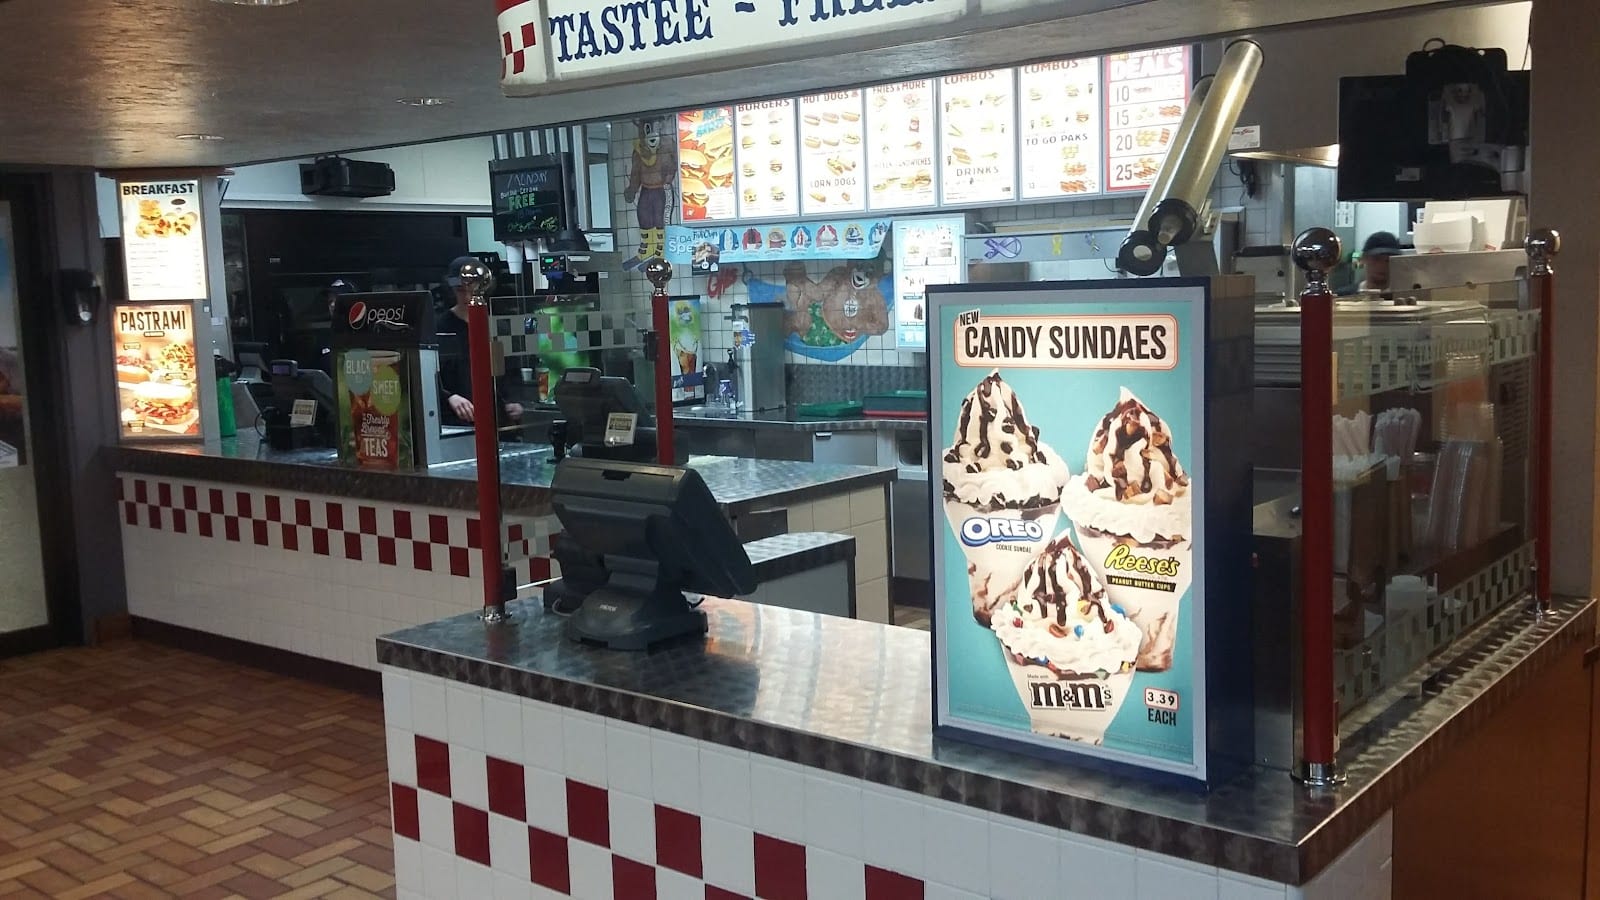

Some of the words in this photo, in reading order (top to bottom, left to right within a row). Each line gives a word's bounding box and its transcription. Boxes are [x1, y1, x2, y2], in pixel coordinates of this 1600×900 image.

[549, 0, 714, 62] TASTEE
[1024, 60, 1078, 74] COMBOS
[944, 70, 995, 85] COMBOS
[873, 84, 895, 94] FRIES
[902, 80, 926, 91] MORE
[1115, 86, 1130, 102] 10
[803, 94, 821, 104] HOT
[824, 91, 849, 102] DOGS
[738, 100, 790, 113] BURGERS
[1115, 108, 1130, 126] 15
[1026, 138, 1038, 146] TO
[1042, 136, 1057, 145] GO
[1061, 133, 1088, 143] PAKS
[1115, 134, 1133, 151] 20
[956, 166, 999, 177] DRINKS
[1115, 164, 1133, 181] 25
[123, 183, 195, 196] BREAKFAST
[834, 177, 857, 187] DOGS
[508, 192, 536, 211] FREE
[120, 311, 186, 331] PASTRAMI
[367, 304, 406, 325] pepsi
[959, 311, 980, 327] NEW
[964, 325, 1043, 358] CANDY
[1049, 325, 1167, 360] SUNDAES
[346, 360, 371, 375] BLACK
[372, 380, 399, 395] SWEET
[364, 438, 388, 458] TEAS
[961, 517, 1043, 546] OREO
[1104, 543, 1181, 577] Reese's
[1111, 577, 1133, 586] PEANUT
[1134, 580, 1155, 588] BUTTER
[1156, 583, 1171, 591] CUPS
[1147, 692, 1175, 707] 3.39
[1148, 709, 1177, 727] EACH
